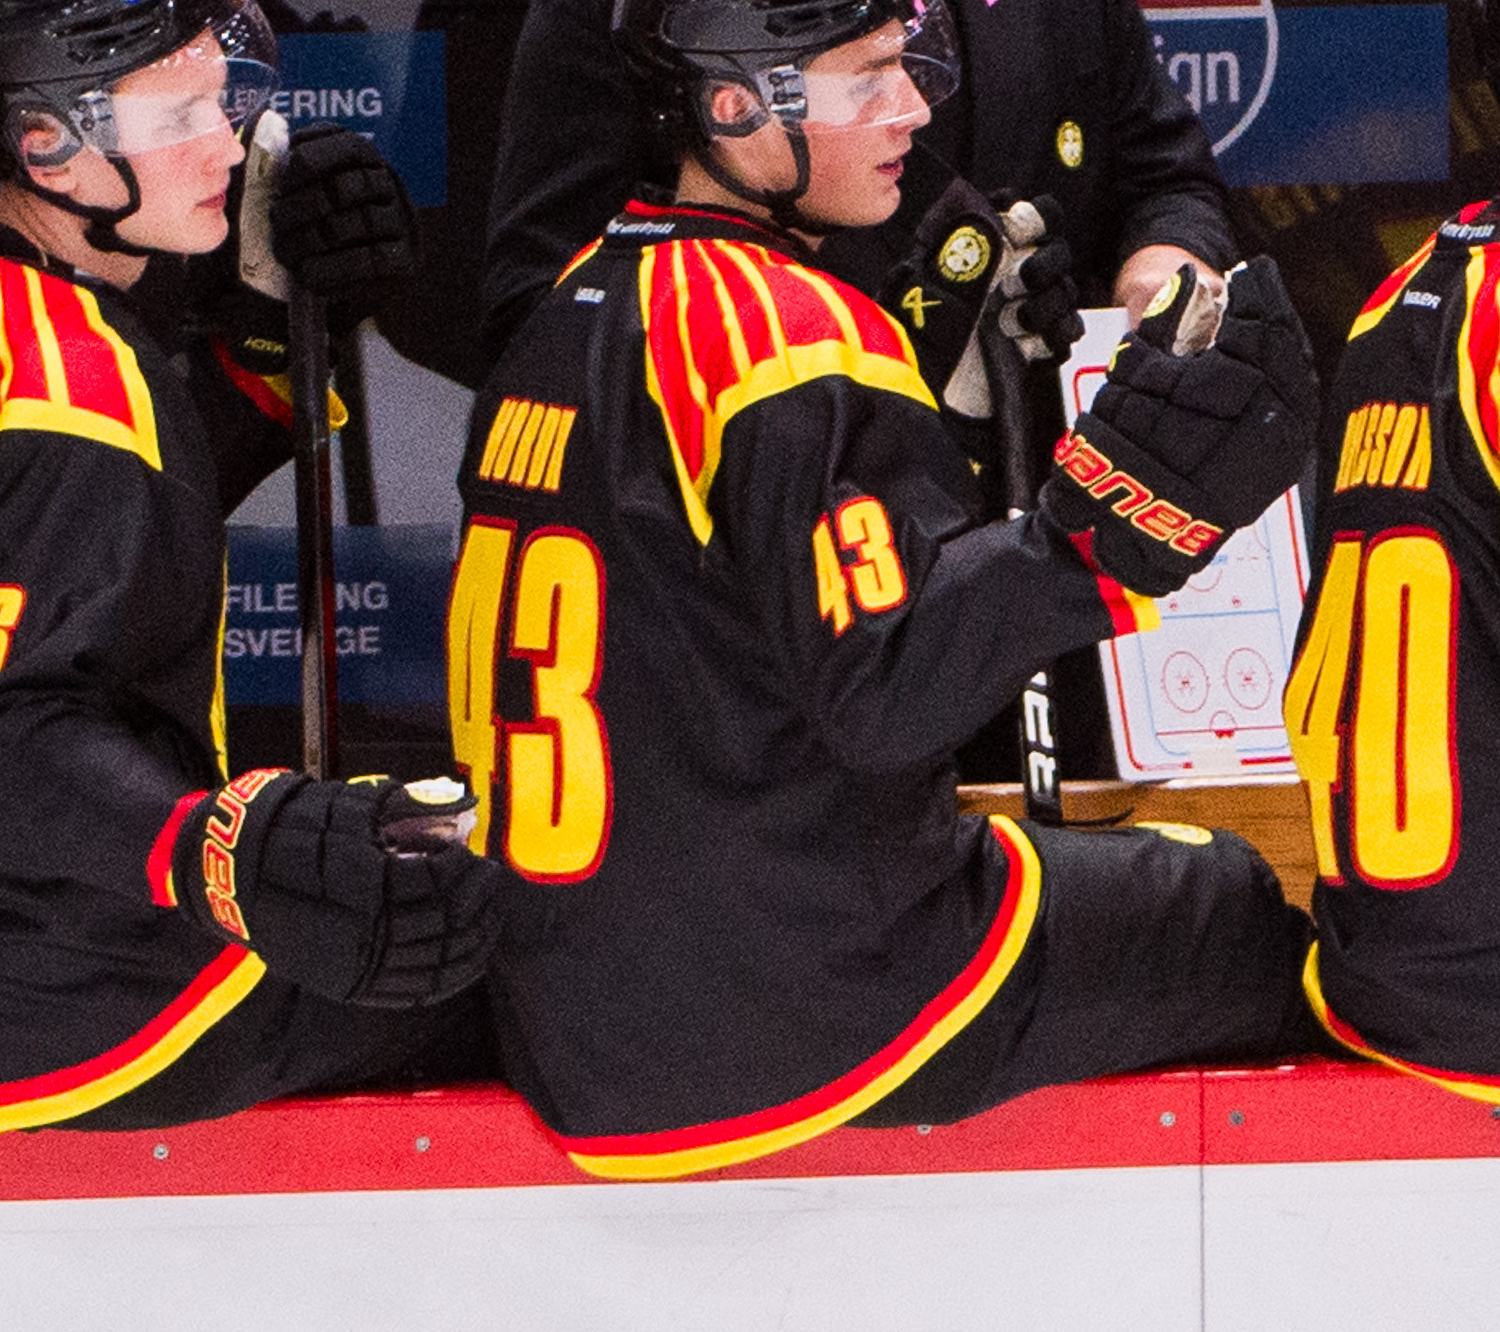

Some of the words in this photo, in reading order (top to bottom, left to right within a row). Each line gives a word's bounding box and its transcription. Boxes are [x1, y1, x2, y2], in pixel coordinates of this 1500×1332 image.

[445, 514, 614, 885] 43
[811, 495, 908, 638] 43
[1281, 525, 1462, 890] 40
